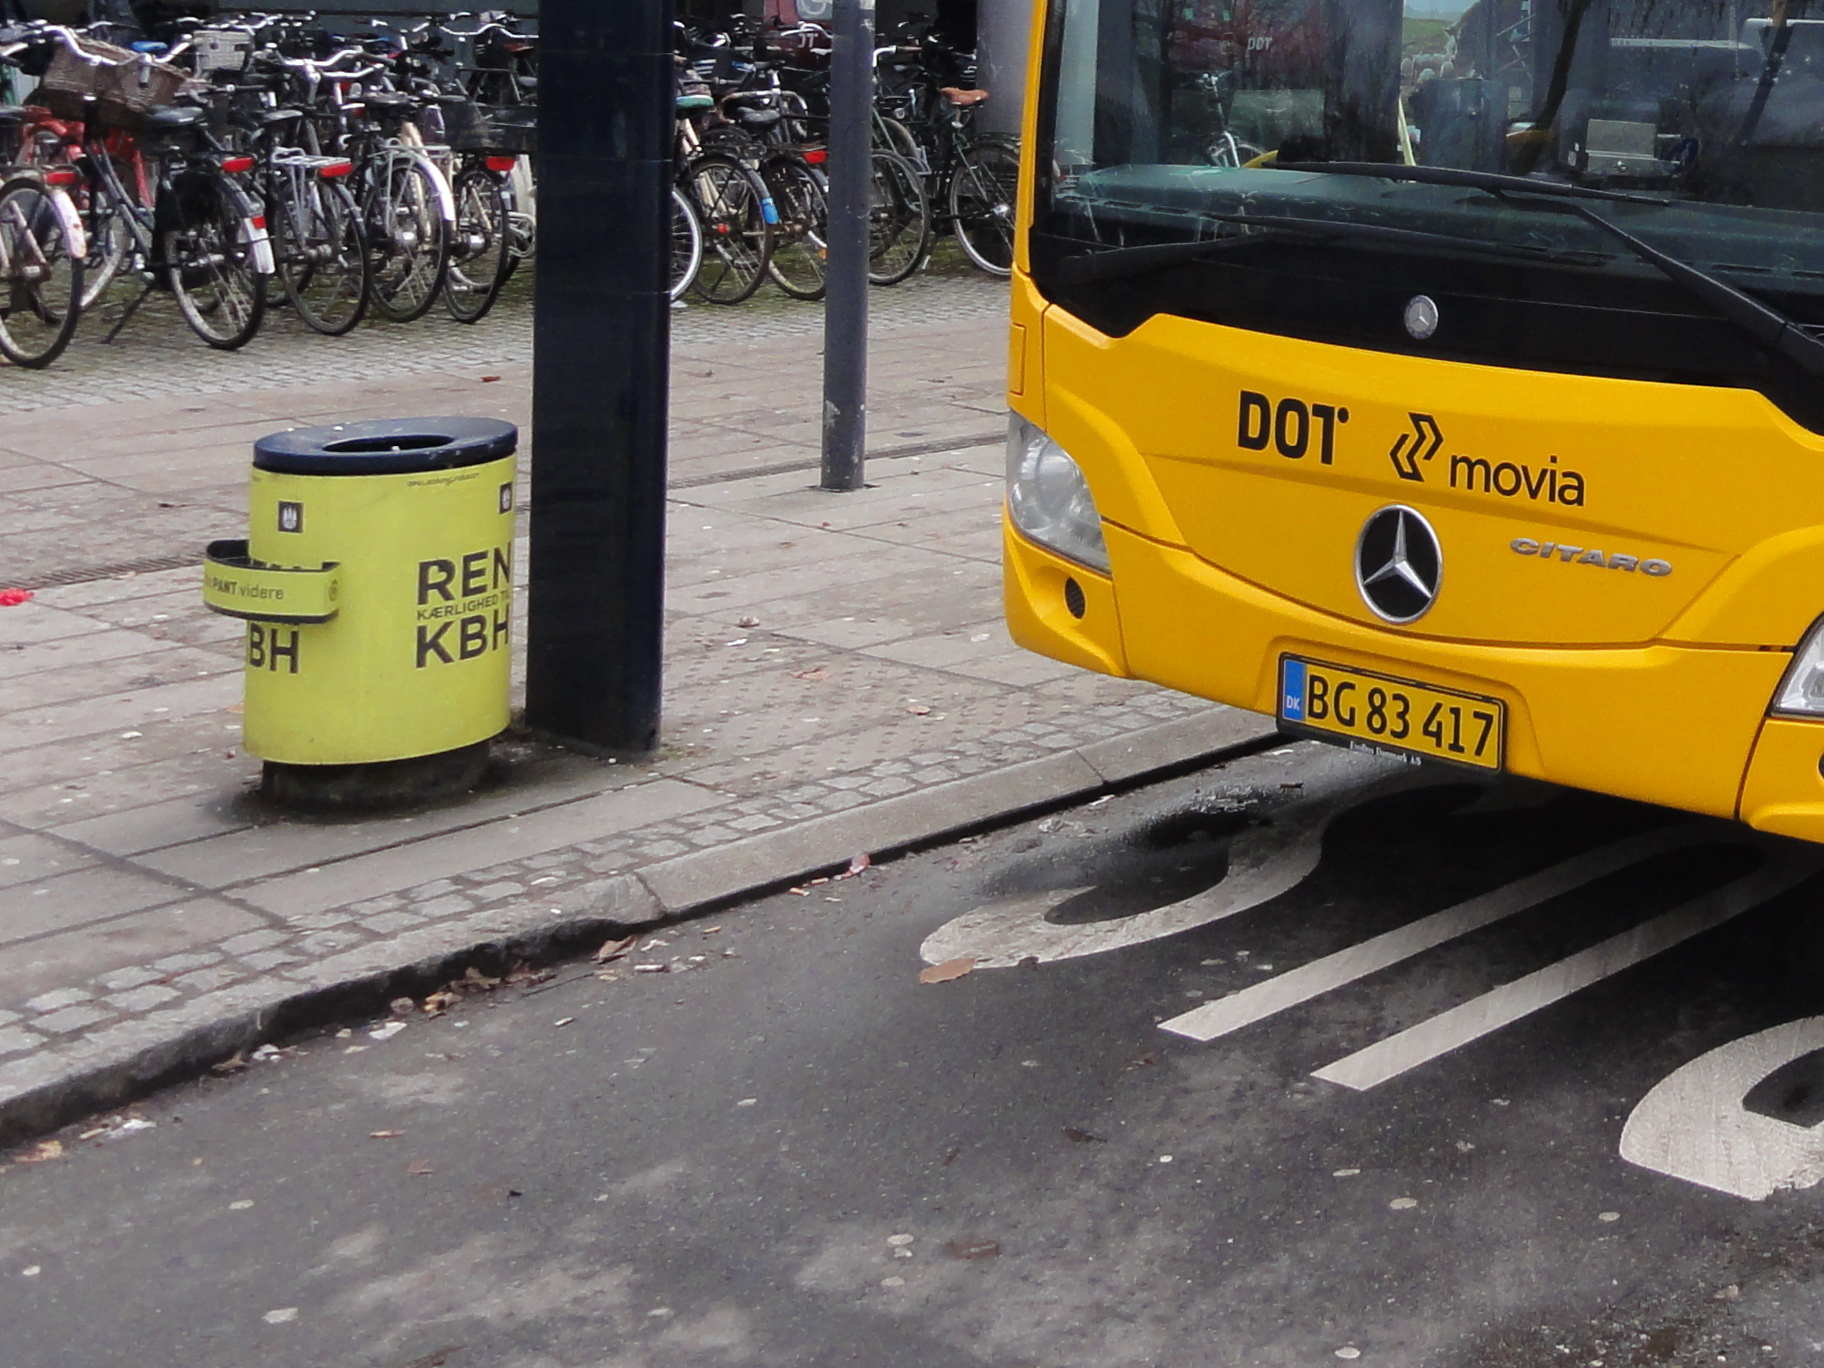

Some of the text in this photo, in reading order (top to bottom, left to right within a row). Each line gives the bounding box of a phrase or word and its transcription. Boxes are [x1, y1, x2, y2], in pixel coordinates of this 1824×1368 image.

[1237, 389, 1349, 466] DOT
[1450, 454, 1585, 507] movia
[416, 540, 512, 606] REN
[1509, 536, 1673, 577] CITARO
[240, 584, 284, 600] videre
[416, 594, 498, 622] KÆRLIGHED
[415, 603, 510, 669] KBH
[1286, 694, 1300, 711] DK
[1308, 674, 1495, 758] BG 83 417
